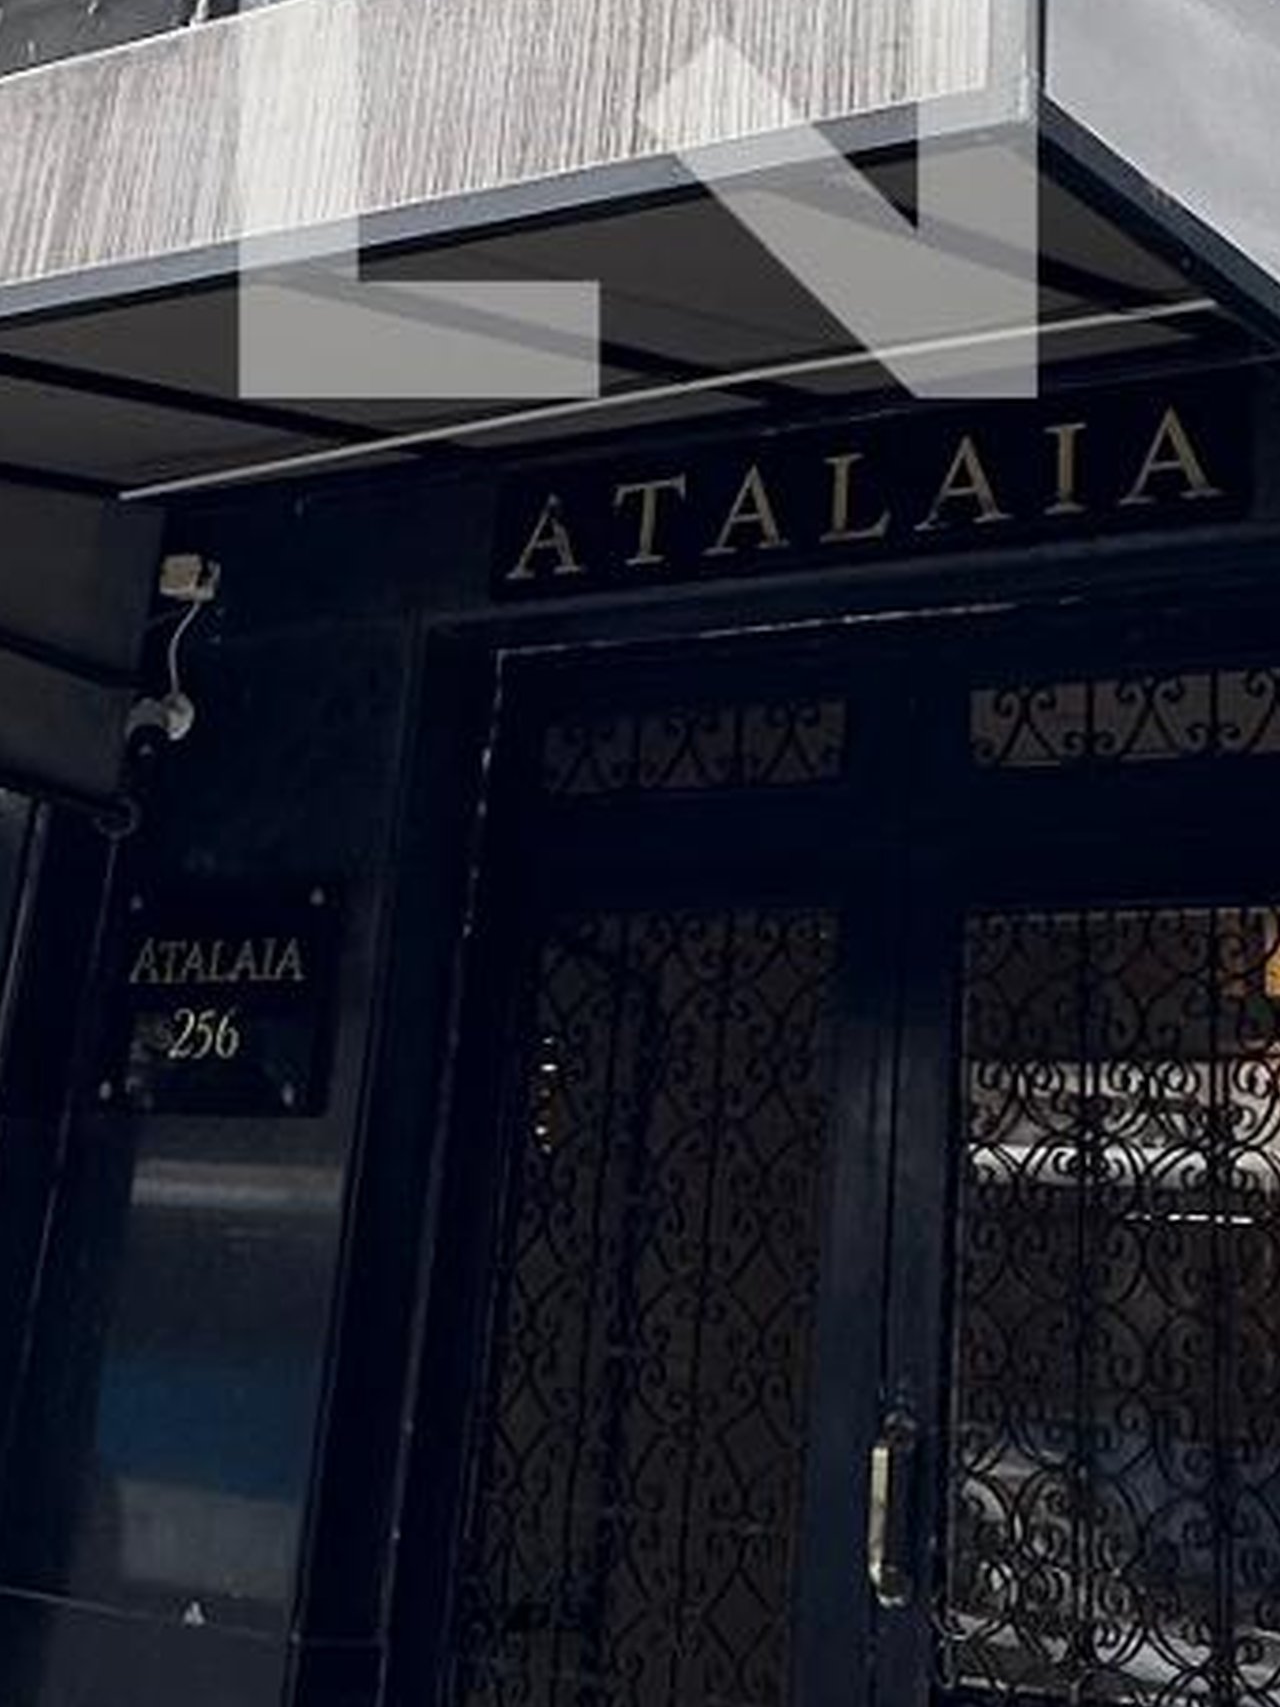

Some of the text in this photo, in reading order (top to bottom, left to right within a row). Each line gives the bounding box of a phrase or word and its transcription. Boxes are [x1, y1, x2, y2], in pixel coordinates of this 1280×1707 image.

[506, 406, 1223, 580] ATALAIA
[128, 937, 308, 985] ATALAIA
[167, 1006, 241, 1059] 256
